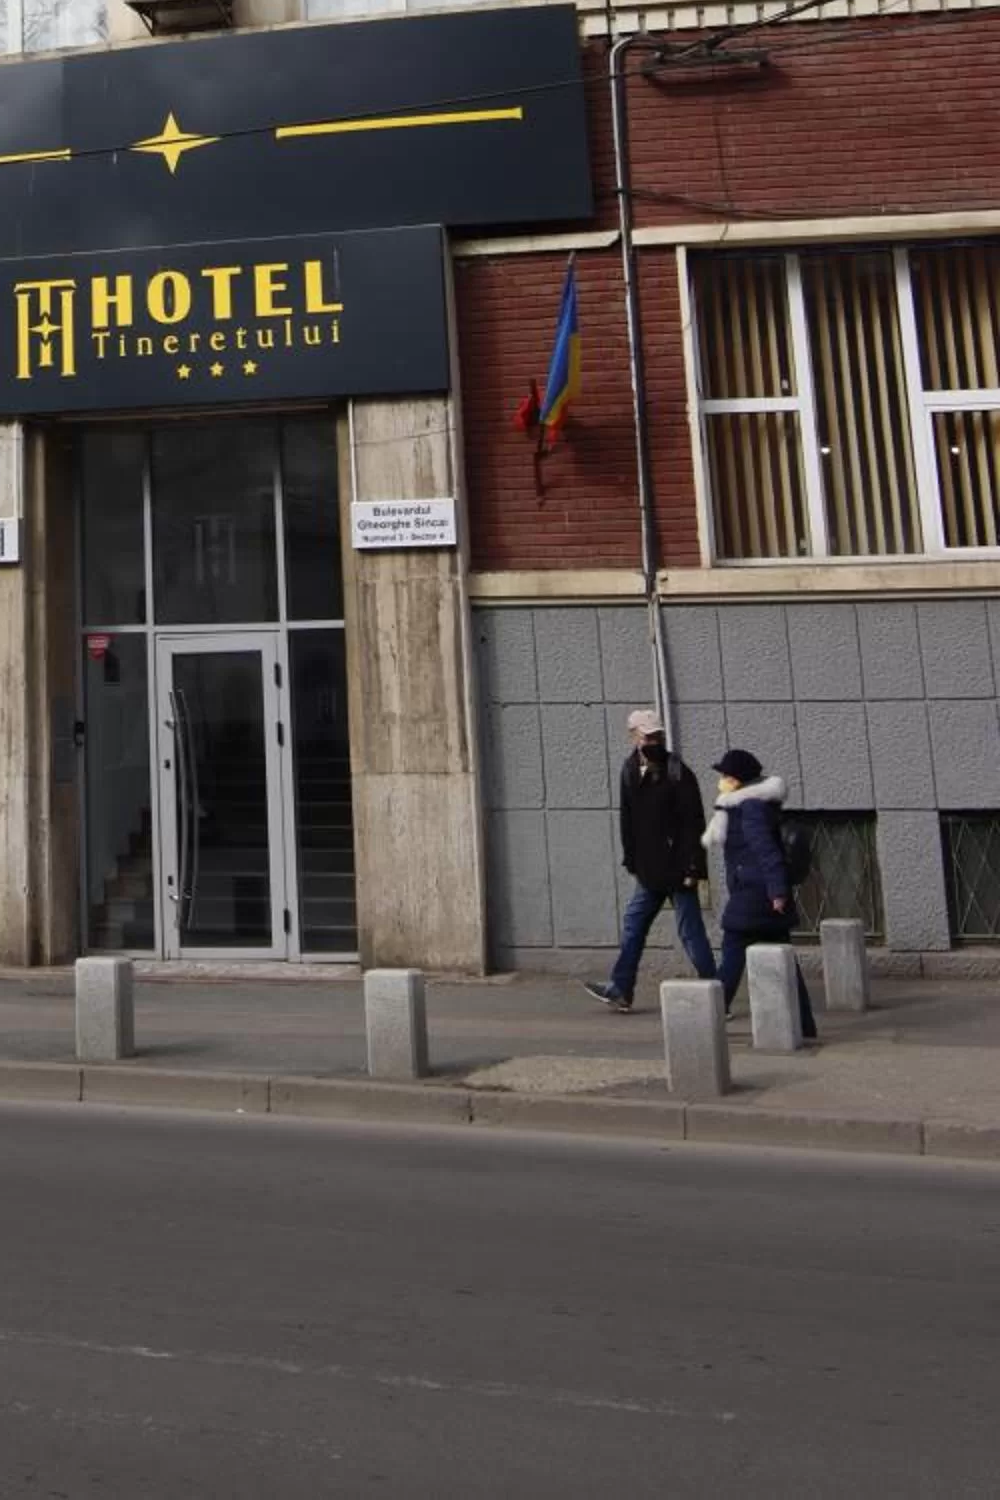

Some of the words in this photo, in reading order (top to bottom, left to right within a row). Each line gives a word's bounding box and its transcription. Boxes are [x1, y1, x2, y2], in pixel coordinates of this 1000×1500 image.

[91, 260, 343, 329] HOTEL
[91, 318, 341, 359] Tineretului
[372, 505, 431, 517] Bulevardul
[357, 519, 411, 531] Gheorghe
